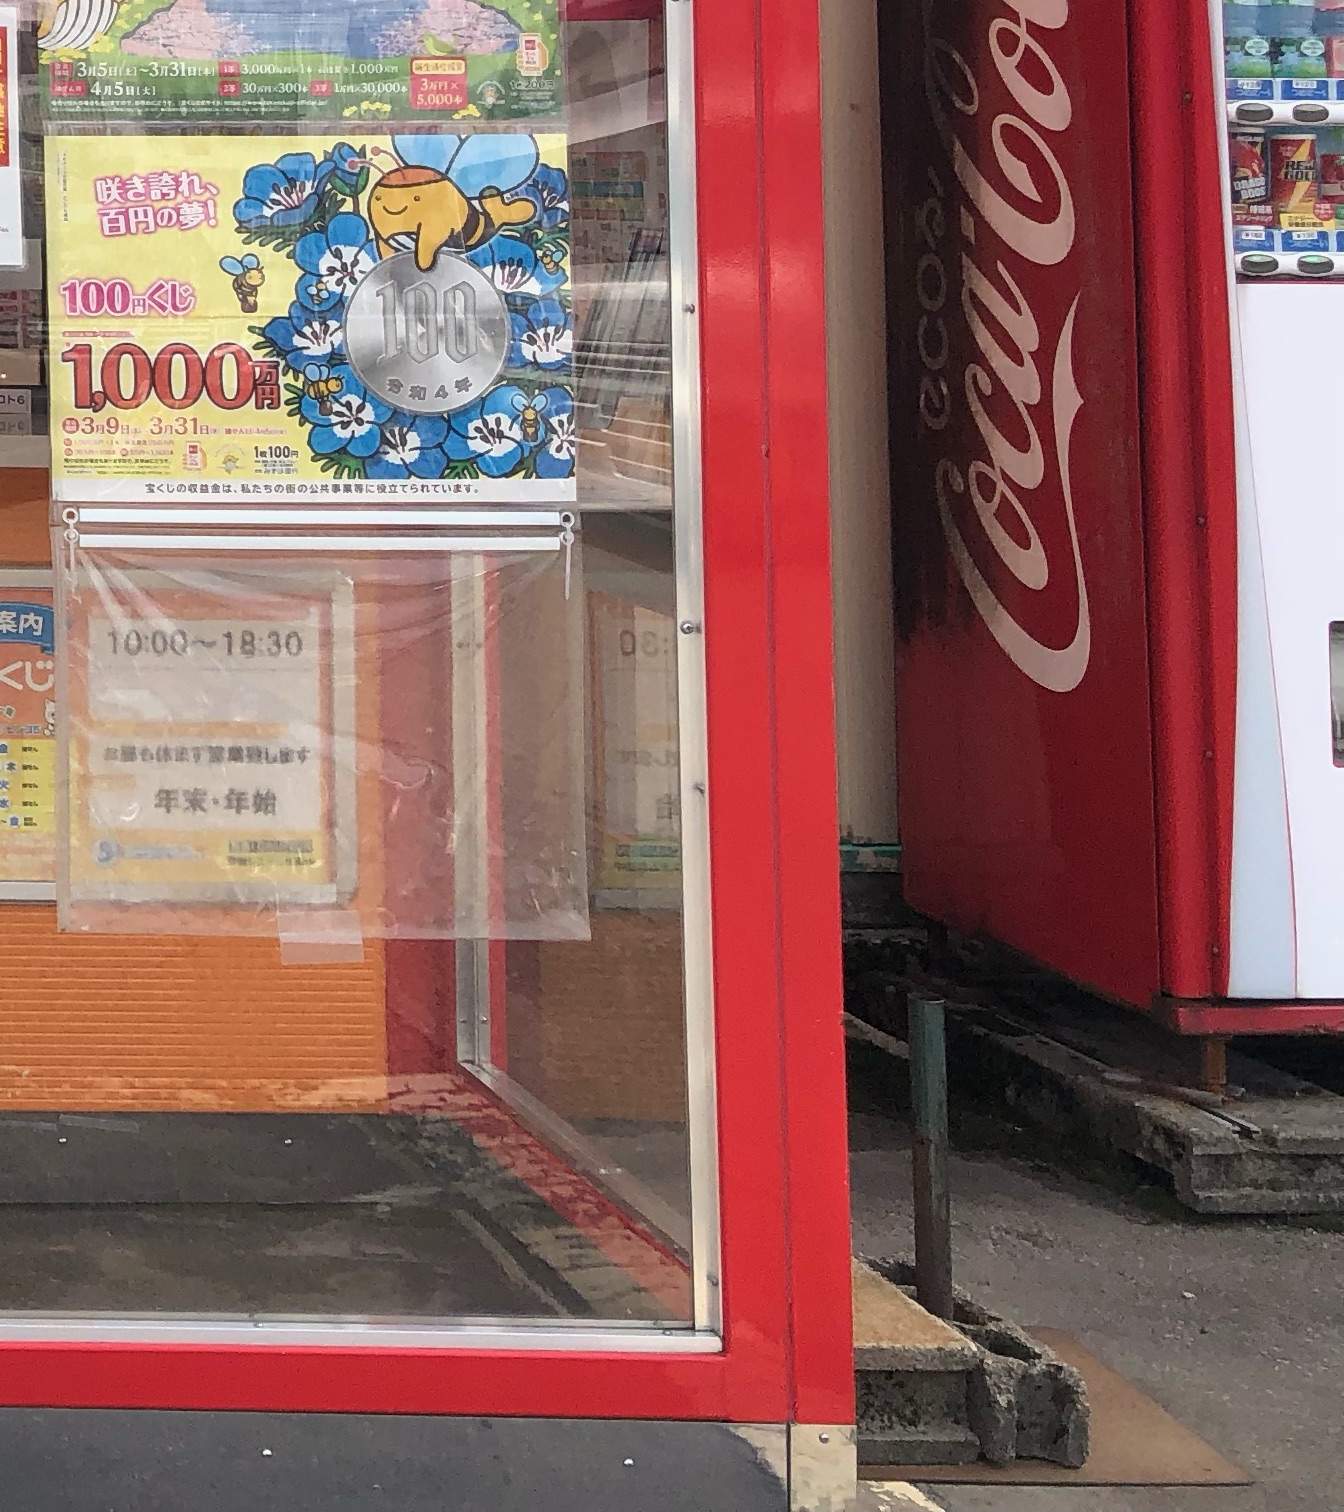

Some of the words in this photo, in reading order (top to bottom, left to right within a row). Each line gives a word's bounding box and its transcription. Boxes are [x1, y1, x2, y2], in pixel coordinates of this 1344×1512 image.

[62, 279, 194, 316] 100円くじ
[375, 281, 478, 365] 100
[61, 343, 282, 412] 1,000万円
